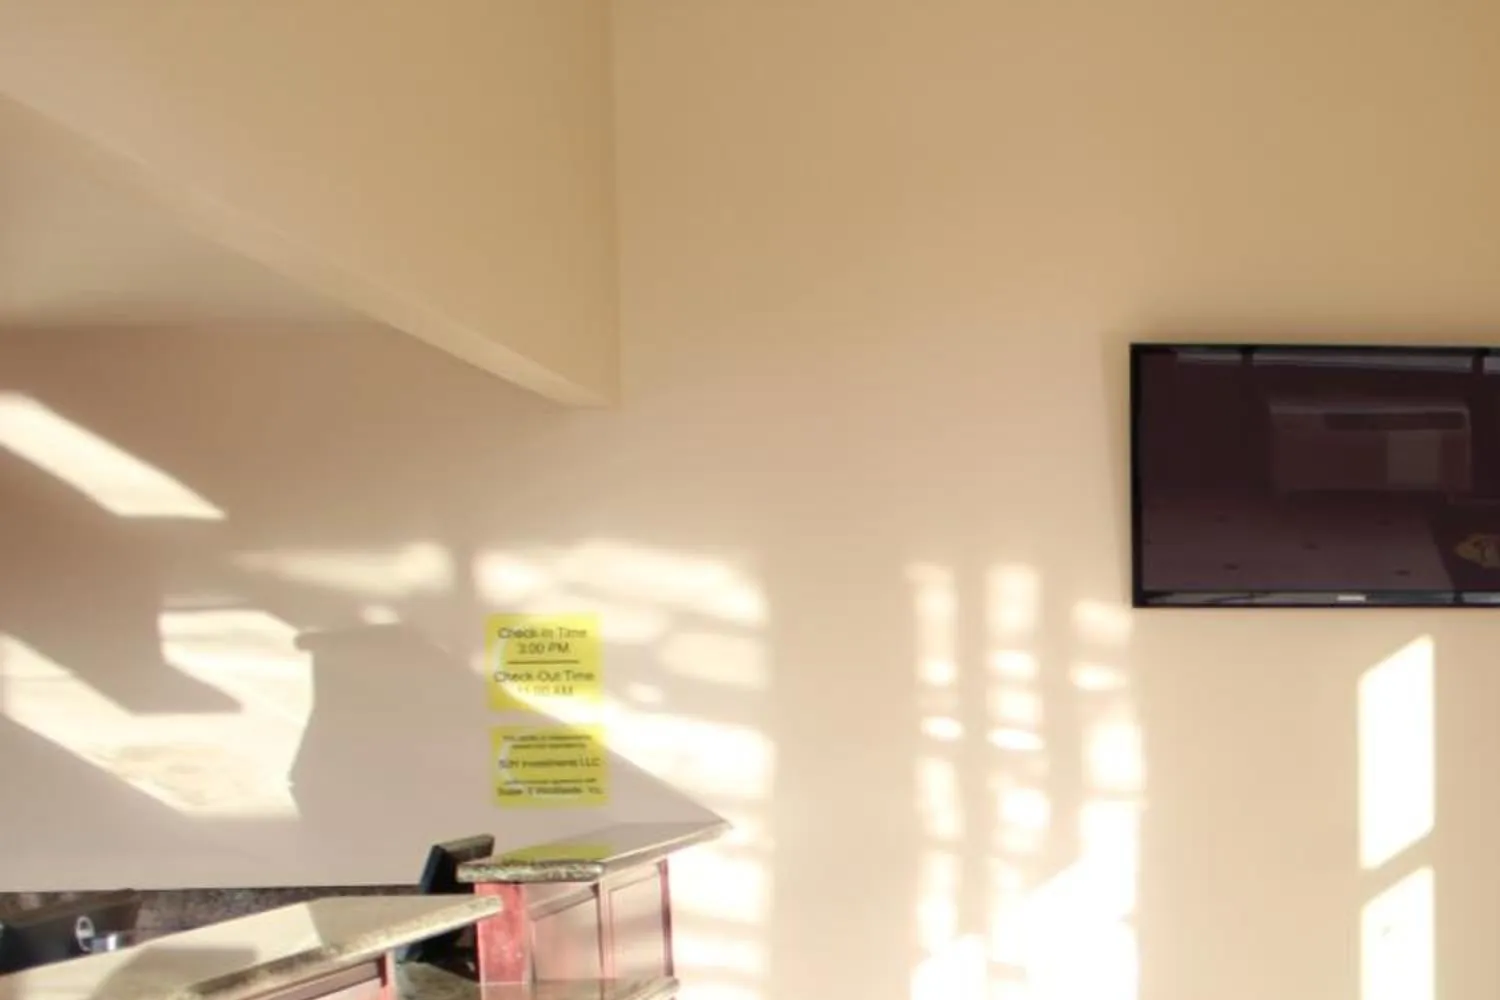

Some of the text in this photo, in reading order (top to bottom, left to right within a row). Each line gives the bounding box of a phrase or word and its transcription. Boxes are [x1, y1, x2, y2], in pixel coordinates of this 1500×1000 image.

[558, 626, 588, 639] Time
[547, 642, 571, 654] PM
[563, 669, 596, 682] Time
